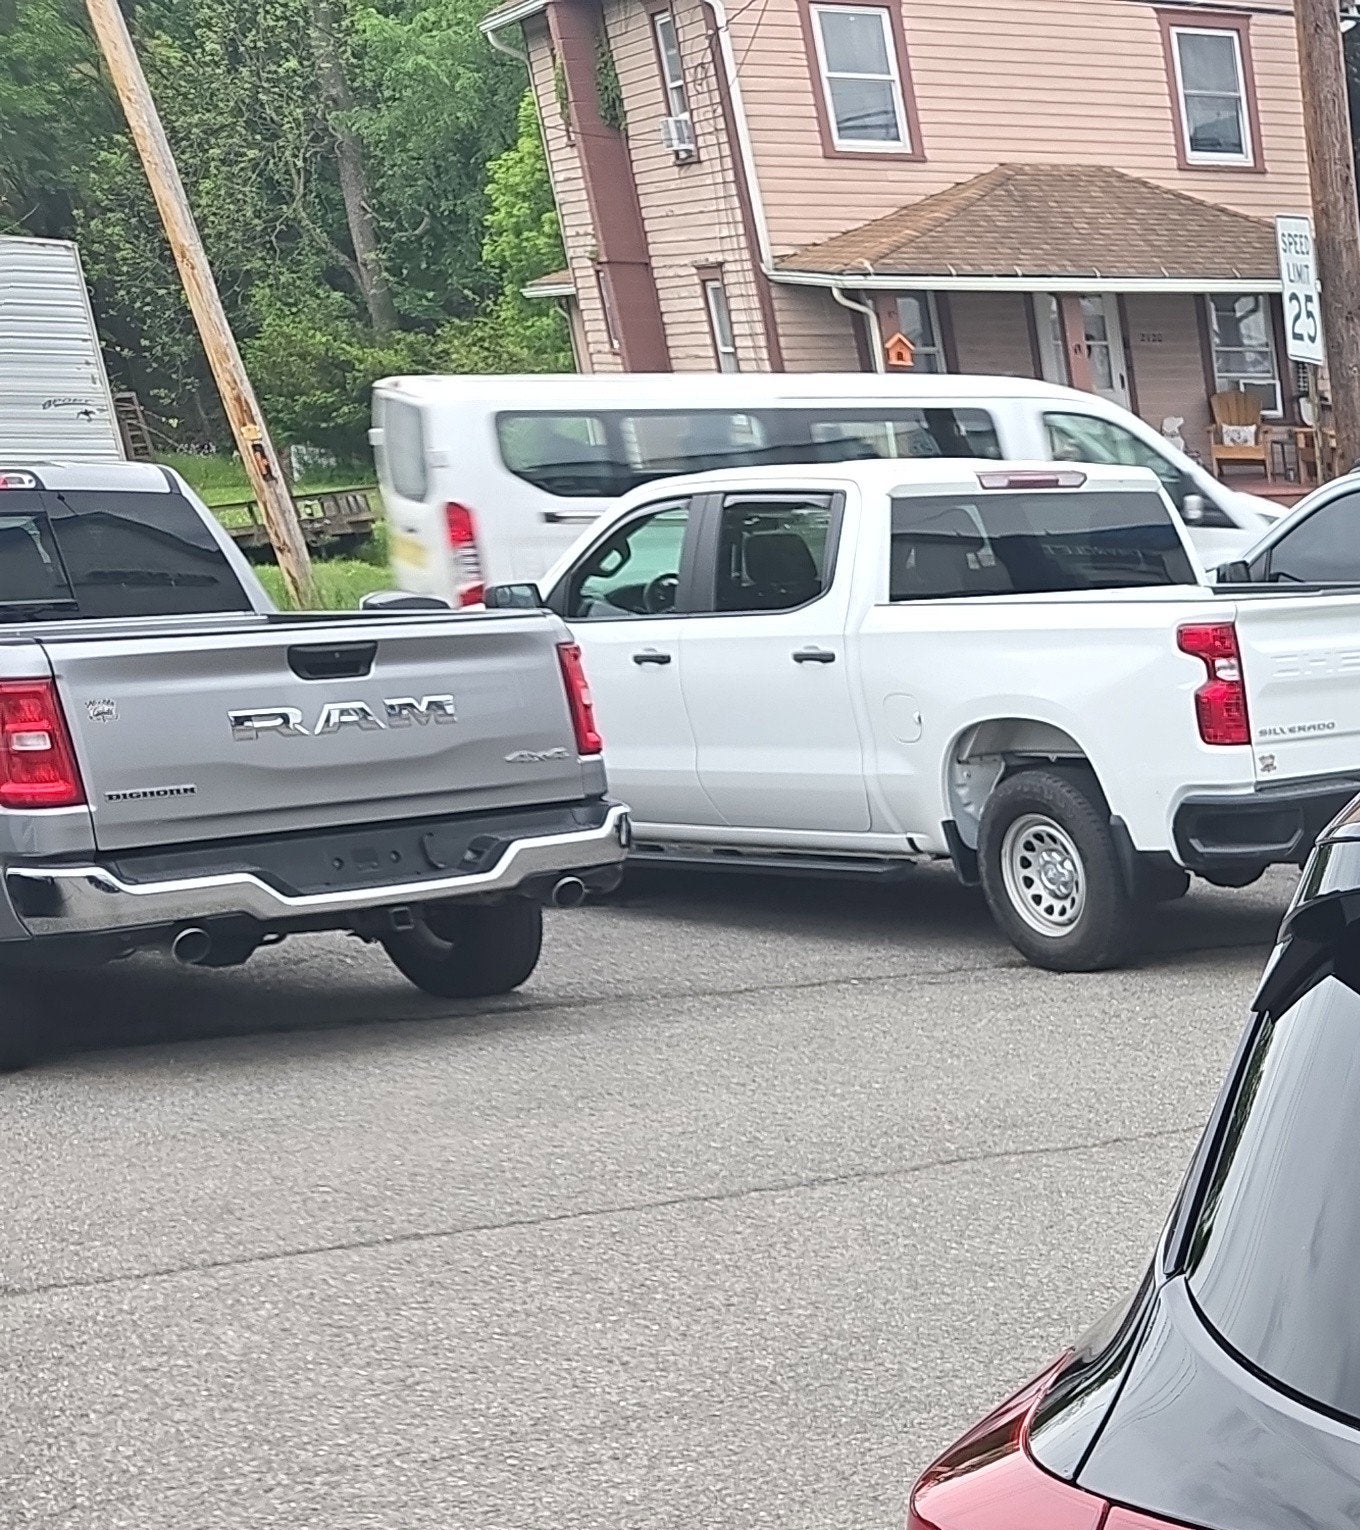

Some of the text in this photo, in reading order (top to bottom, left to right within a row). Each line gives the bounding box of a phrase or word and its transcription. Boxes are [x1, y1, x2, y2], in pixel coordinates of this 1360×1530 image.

[1280, 232, 1310, 256] SPEED
[1286, 262, 1311, 286] LIMIT
[1288, 291, 1318, 344] 25
[227, 693, 458, 741] RAM
[1258, 721, 1336, 738] SILVERADO
